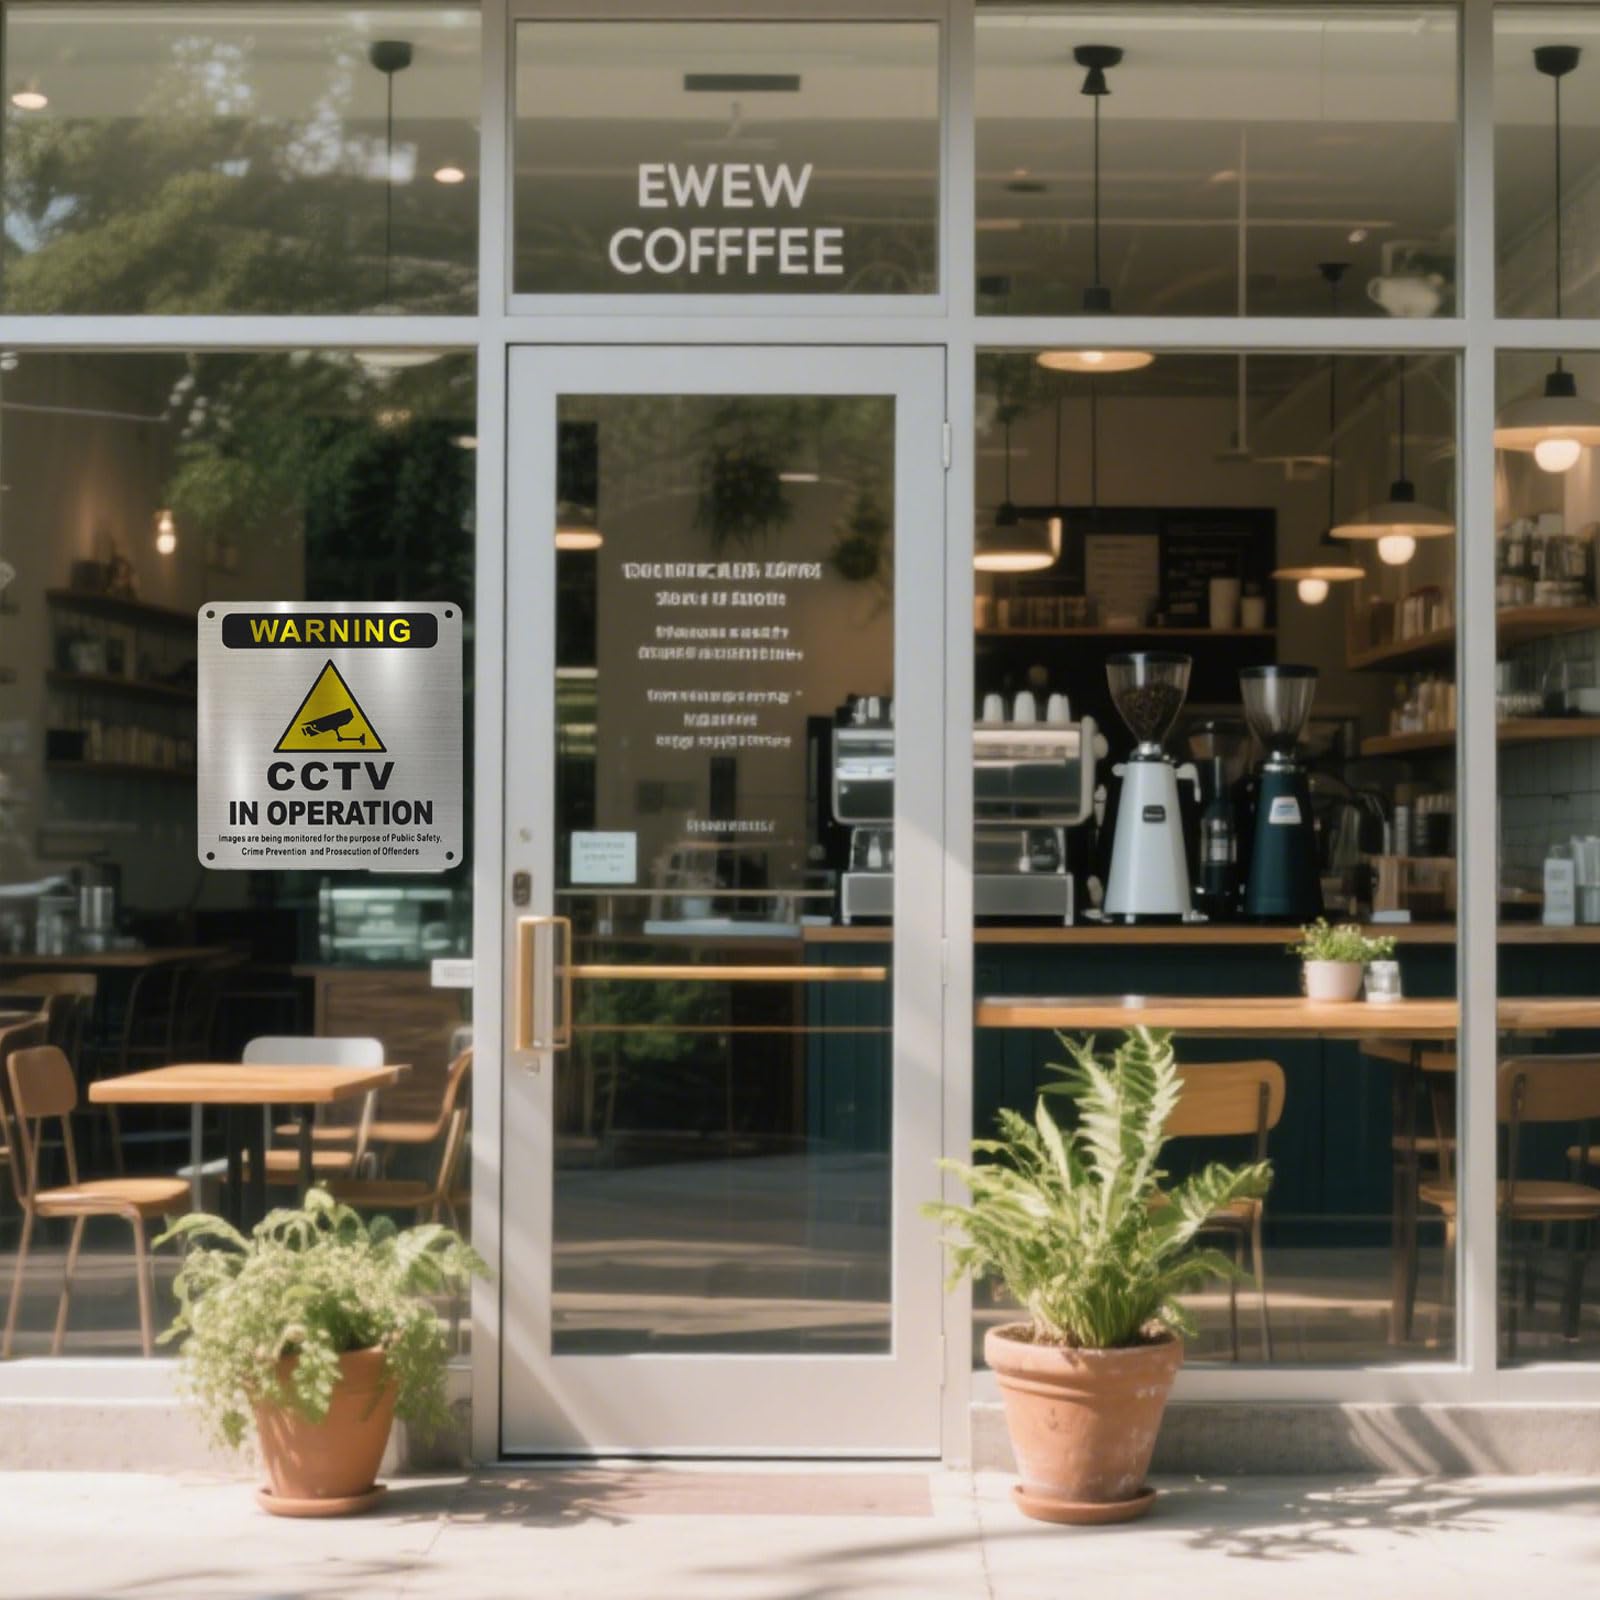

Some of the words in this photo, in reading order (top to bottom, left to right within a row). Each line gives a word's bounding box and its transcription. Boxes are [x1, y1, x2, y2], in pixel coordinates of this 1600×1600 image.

[638, 163, 813, 208] EWEW
[608, 227, 844, 275] COFFFEE
[249, 618, 412, 643] WARNING
[266, 761, 395, 791] CCTV
[229, 801, 258, 825] IN
[267, 801, 433, 825] OPERATION
[218, 834, 246, 844] Images
[261, 834, 282, 844] being
[283, 834, 322, 842] monitored
[323, 834, 335, 842] for
[335, 834, 348, 842] the
[349, 836, 381, 844] purpose
[382, 834, 390, 842] of
[391, 834, 415, 842] Public
[241, 847, 264, 856] Crime
[265, 847, 307, 856] Prevention
[310, 847, 324, 856] and
[325, 847, 372, 856] Prosecution
[372, 847, 381, 856] of
[382, 847, 420, 856] Offenders
